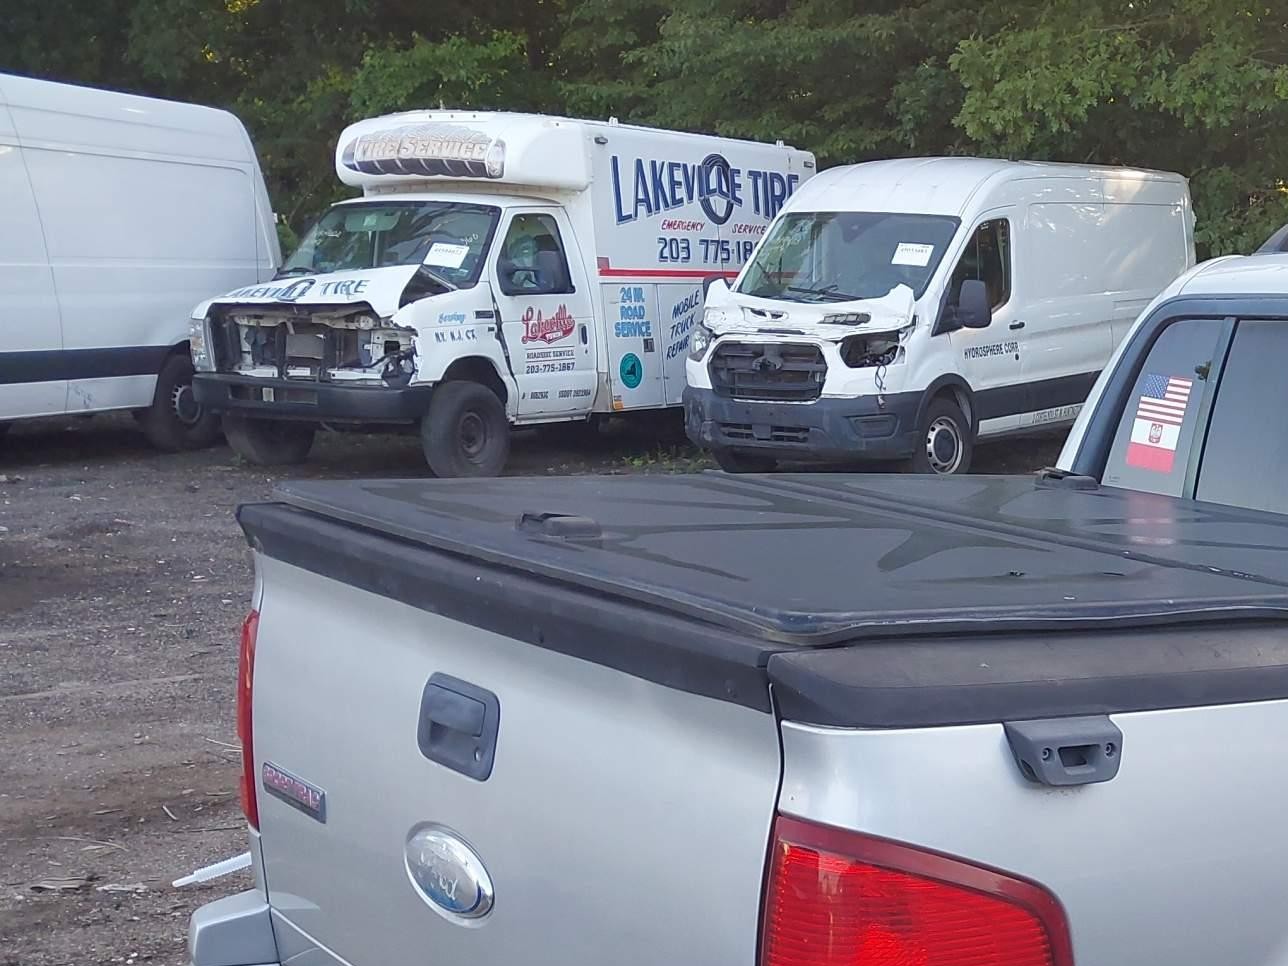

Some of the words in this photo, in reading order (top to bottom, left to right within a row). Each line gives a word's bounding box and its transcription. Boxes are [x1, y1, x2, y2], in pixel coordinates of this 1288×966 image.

[399, 137, 487, 160] SERVICE
[611, 155, 744, 226] LAKEVILLE
[661, 219, 706, 232] EMERGENCY
[732, 223, 767, 235] SERVICE
[657, 237, 691, 264] 203
[320, 279, 371, 296] TIRE
[619, 287, 632, 303] 24
[620, 305, 646, 320] ROAD
[672, 290, 700, 320] MOBILE
[521, 303, 576, 344] Lakeville
[615, 321, 652, 337] SERVICE
[670, 312, 696, 340] TRUCK
[666, 335, 690, 361] REPAIR
[964, 343, 1004, 360] HYDROSPHERE
[1004, 341, 1020, 354] CORP.
[526, 362, 576, 375] 203-775-1867
